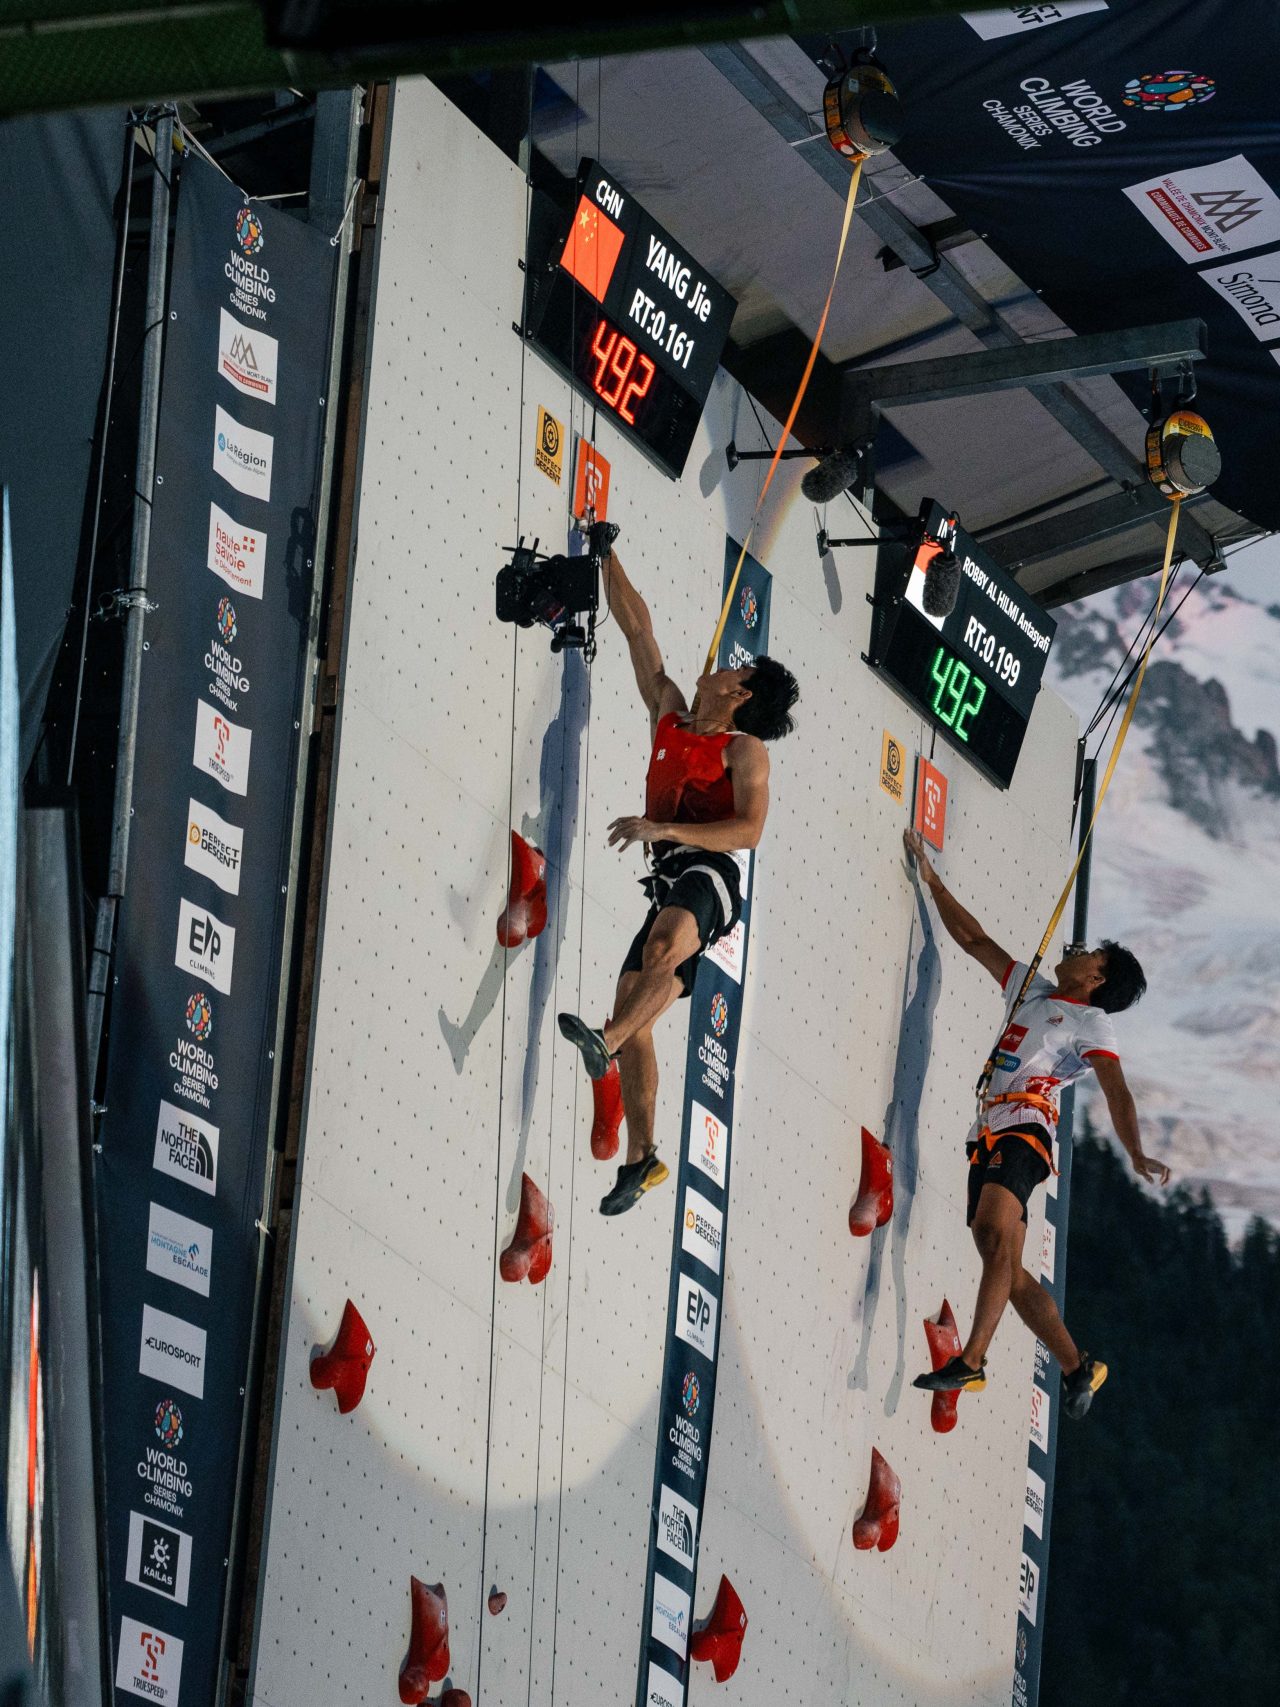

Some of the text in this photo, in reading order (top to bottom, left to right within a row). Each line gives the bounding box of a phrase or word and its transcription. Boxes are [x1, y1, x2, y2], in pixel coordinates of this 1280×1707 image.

[1013, 105, 1052, 137] SERIES
[1019, 77, 1102, 148] CLIMBING
[1060, 79, 1127, 134] WORLD
[982, 100, 1042, 150] CHAMONIX
[596, 180, 624, 220] CHN
[230, 250, 270, 284] WORLD
[645, 234, 712, 322] YANG Jie
[224, 262, 276, 303] CLIMBING
[234, 287, 259, 306] SERIES
[230, 292, 267, 321] CHAMONIX
[629, 288, 695, 369] RT:0.161
[536, 448, 562, 473] PERFECT
[536, 457, 561, 486] DESCENT
[216, 522, 240, 554] haute
[216, 542, 246, 572] savoie
[962, 556, 1050, 654] ROBBY AL HILMI Antasyafi
[212, 640, 242, 674] WORLD
[734, 641, 757, 668] WORL
[964, 615, 1020, 688] RT:0.199
[204, 652, 250, 693] CLIMBING
[215, 677, 231, 697] SERIES
[208, 685, 238, 712] CHAMONIX
[201, 840, 239, 870] DESCENT
[202, 828, 240, 858] PERFECT
[189, 959, 216, 980] CLIMBING
[178, 1038, 214, 1070] WORLD
[704, 1034, 728, 1063] WORLD
[169, 1052, 219, 1090] CLIMBING
[698, 1046, 730, 1082] CLIMBING
[174, 1083, 210, 1110] CHAMONIX
[182, 1075, 206, 1095] SERIES
[161, 1129, 198, 1158] NORTH
[178, 1122, 198, 1143] THE
[168, 1150, 195, 1172] FACE
[695, 1225, 720, 1252] DESCENT
[696, 1214, 721, 1240] PERFECT
[173, 1254, 208, 1278] ESCALADE
[146, 1336, 201, 1368] EUROSPORT
[676, 1414, 700, 1443] WORLD
[669, 1428, 702, 1462] CLIMBING
[146, 1447, 188, 1477] WORLD
[138, 1461, 193, 1499] CLIMBING
[153, 1484, 177, 1504] SERIES
[144, 1492, 184, 1518] CHAMONIX
[672, 1504, 685, 1524] THE
[662, 1511, 684, 1536] NORTH
[666, 1530, 682, 1550] FACE
[144, 1565, 173, 1586] KAILAS
[133, 1675, 165, 1700] TRUESPEED
